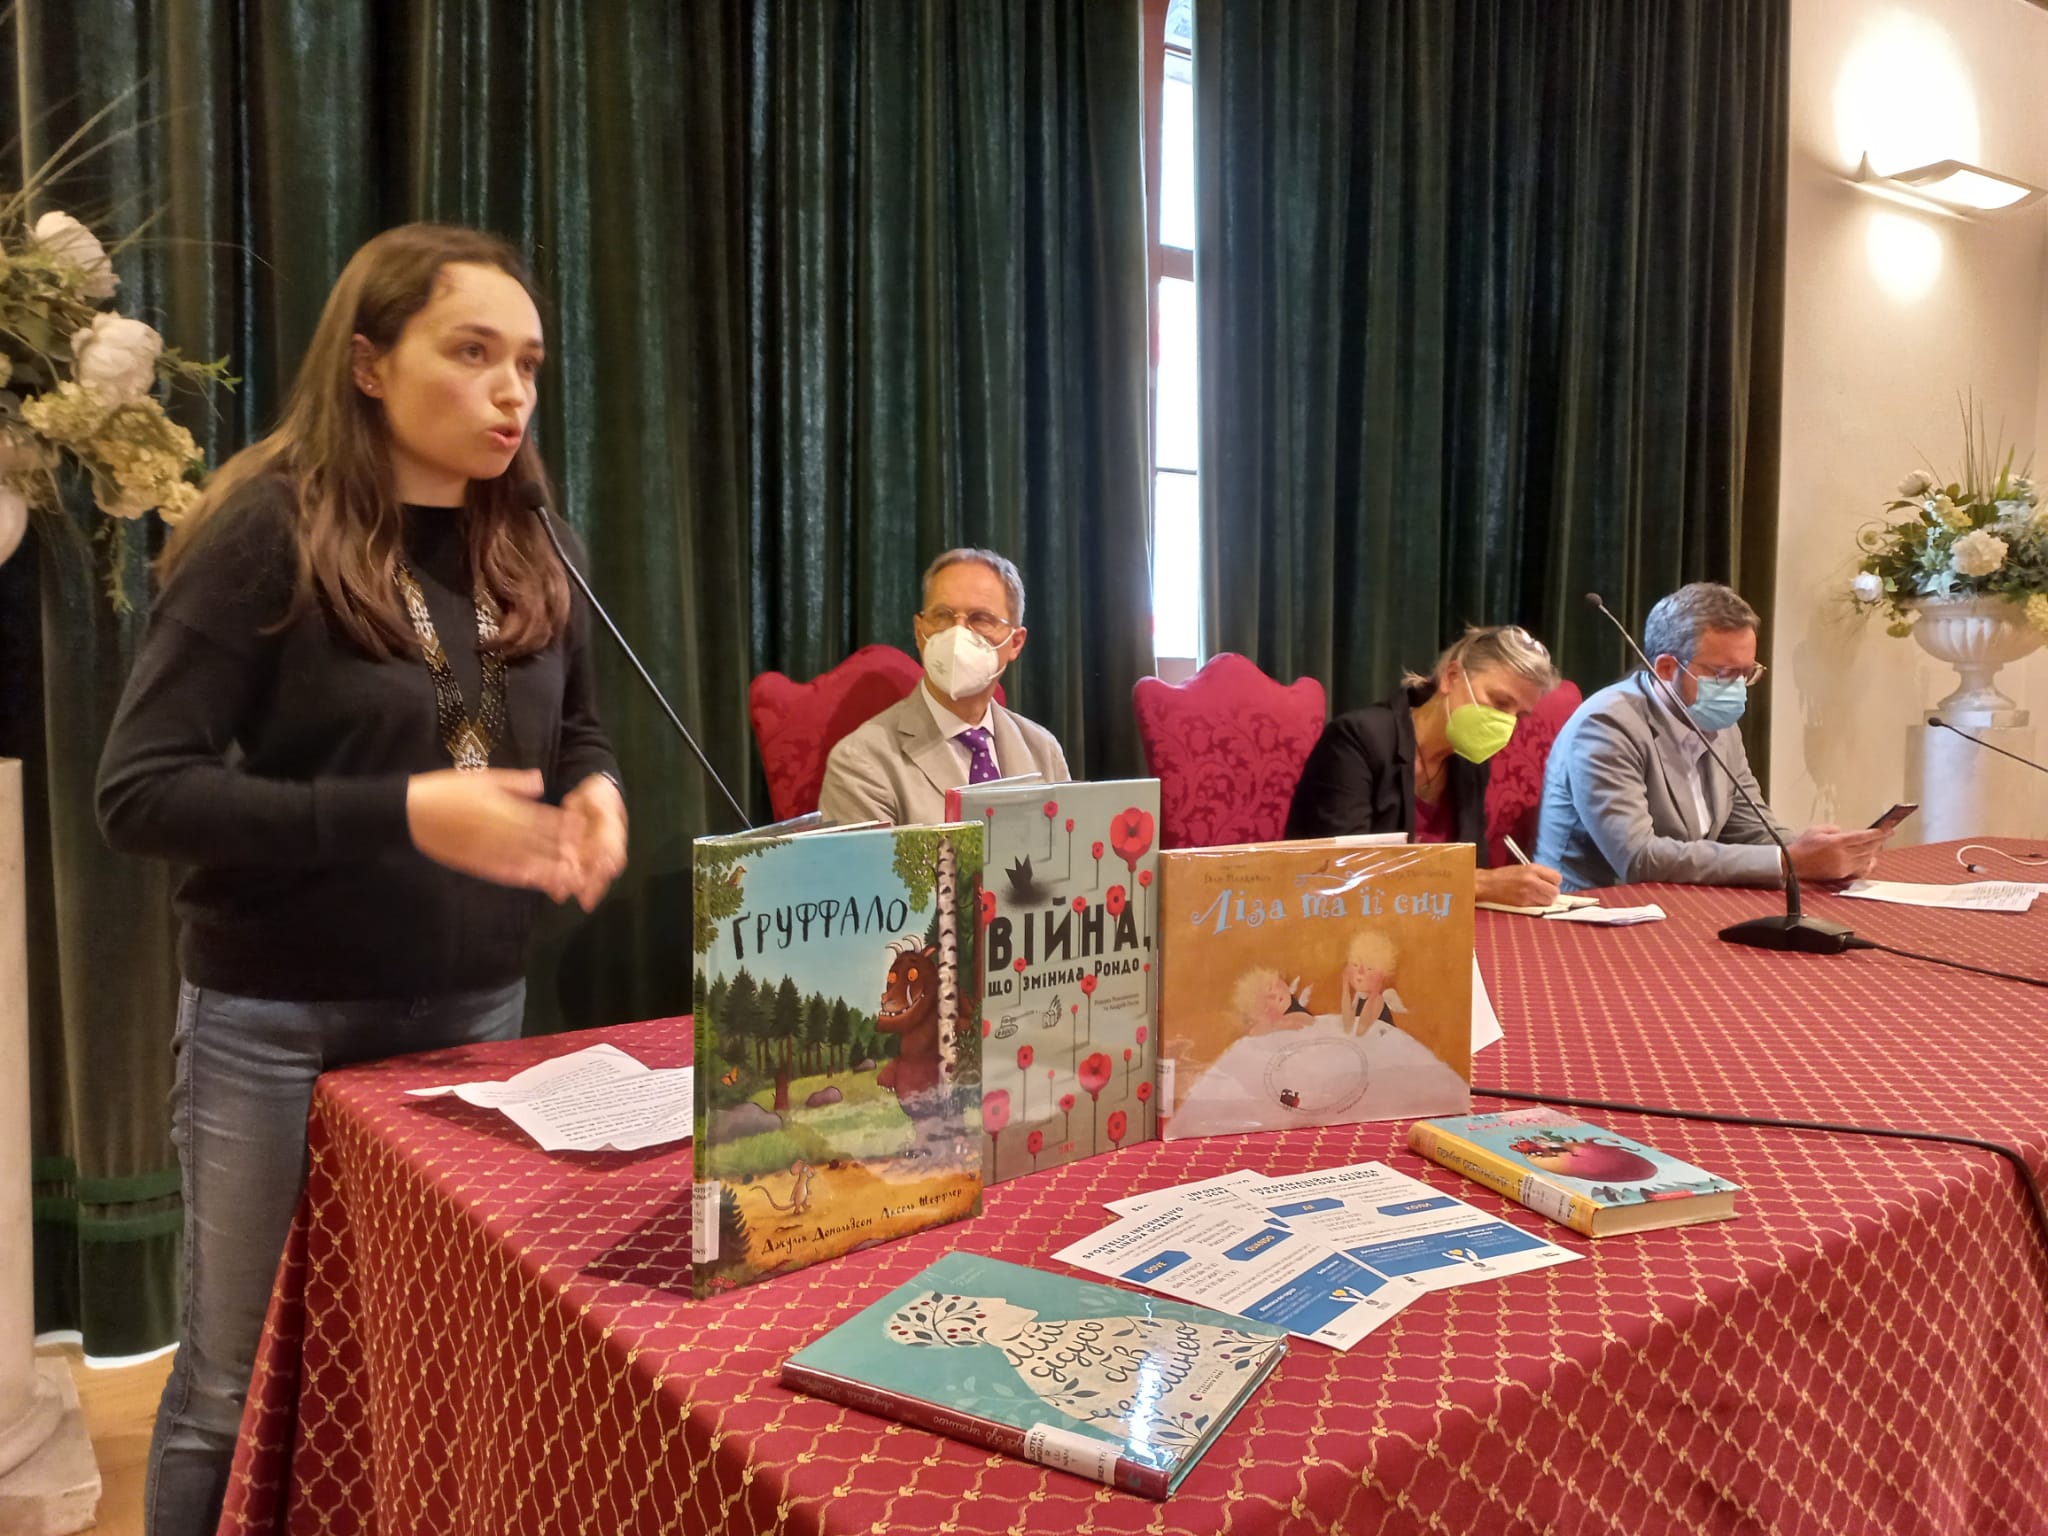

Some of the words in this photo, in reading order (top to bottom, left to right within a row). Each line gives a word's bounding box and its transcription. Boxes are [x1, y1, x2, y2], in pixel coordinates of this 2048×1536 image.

[732, 896, 908, 960] ҐРУФФАЛО
[988, 896, 1151, 972] ВІЙНА,
[1191, 889, 1286, 935] Ліза
[1301, 892, 1347, 918] та
[1082, 1234, 1130, 1259] SPORTELLO
[1130, 1206, 1184, 1235] INFORMATIVO
[1104, 1247, 1117, 1256] IN
[1116, 1232, 1148, 1249] LINGUA
[1147, 1214, 1184, 1233] UCRAINA
[1079, 1321, 1201, 1421] чешнею
